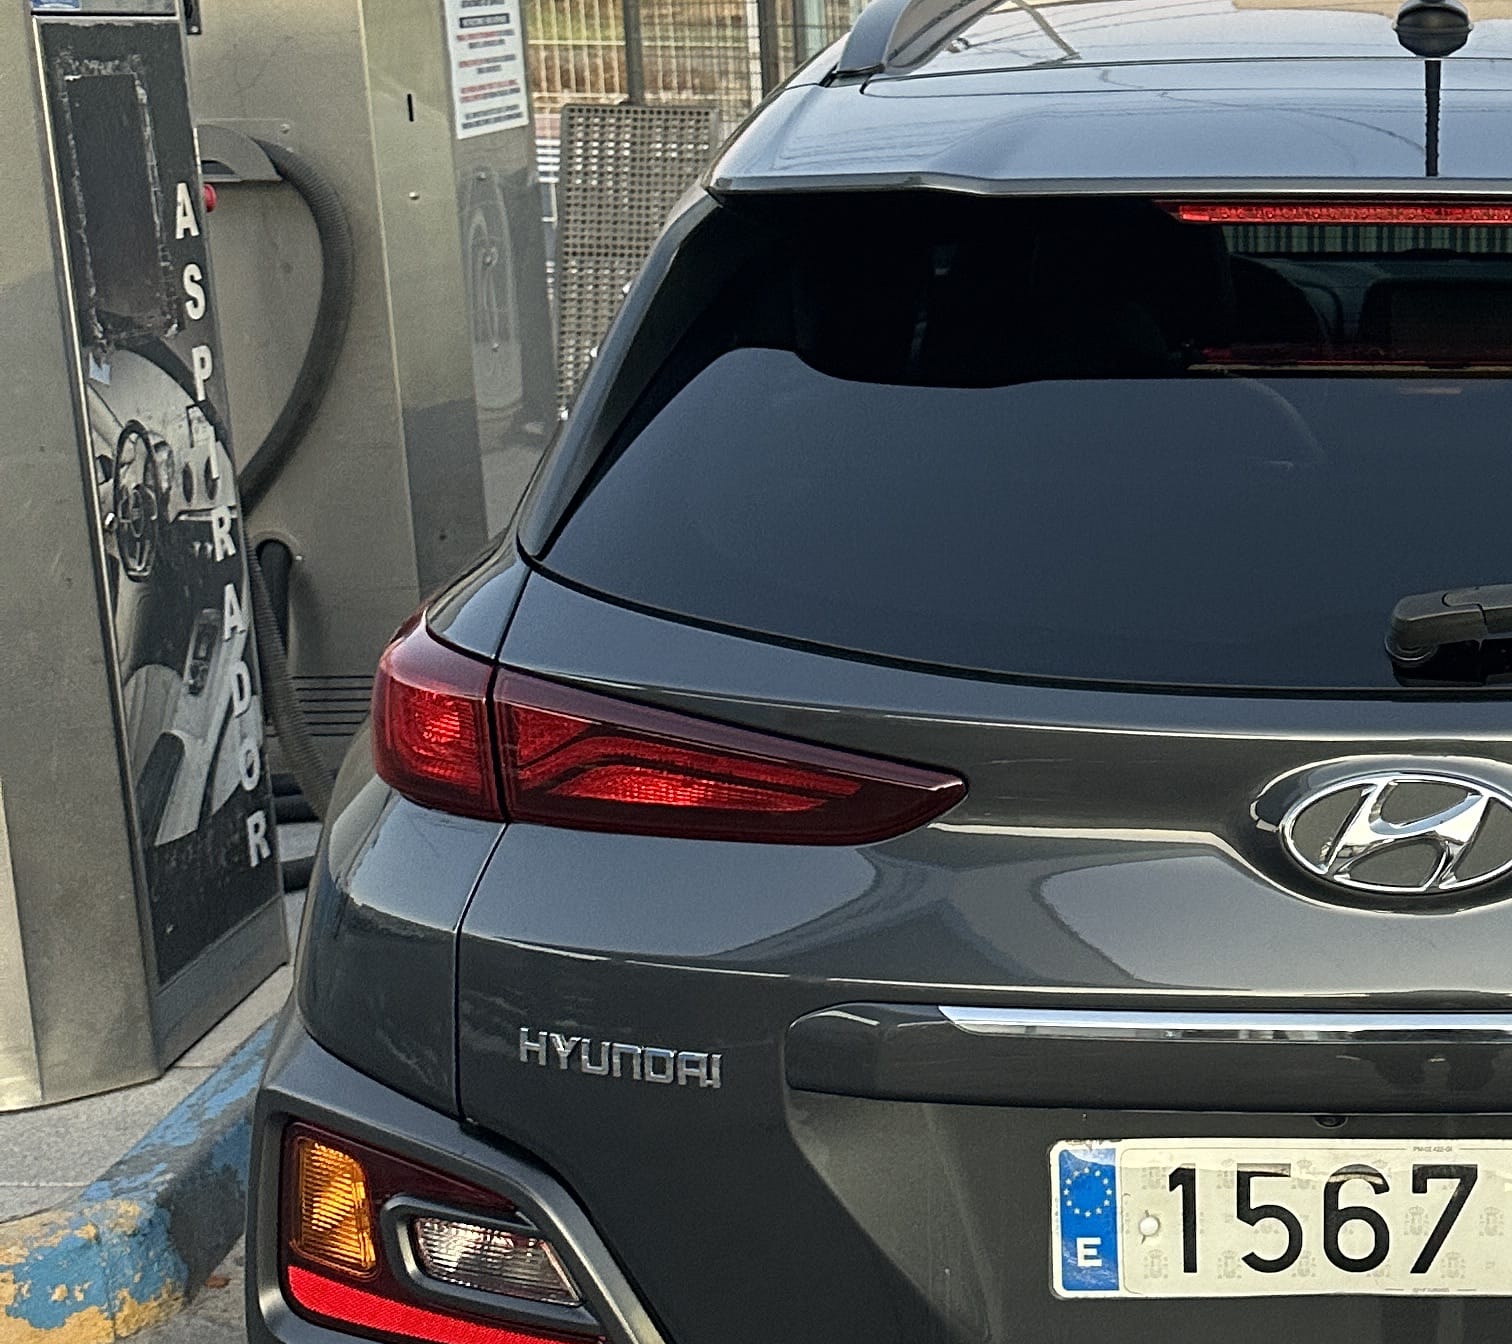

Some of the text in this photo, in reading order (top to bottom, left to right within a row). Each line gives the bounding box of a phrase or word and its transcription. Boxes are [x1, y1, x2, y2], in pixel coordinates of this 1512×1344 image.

[519, 1027, 722, 1089] HYUNDAI
[1075, 1237, 1102, 1267] E
[1167, 1162, 1479, 1274] 1567
